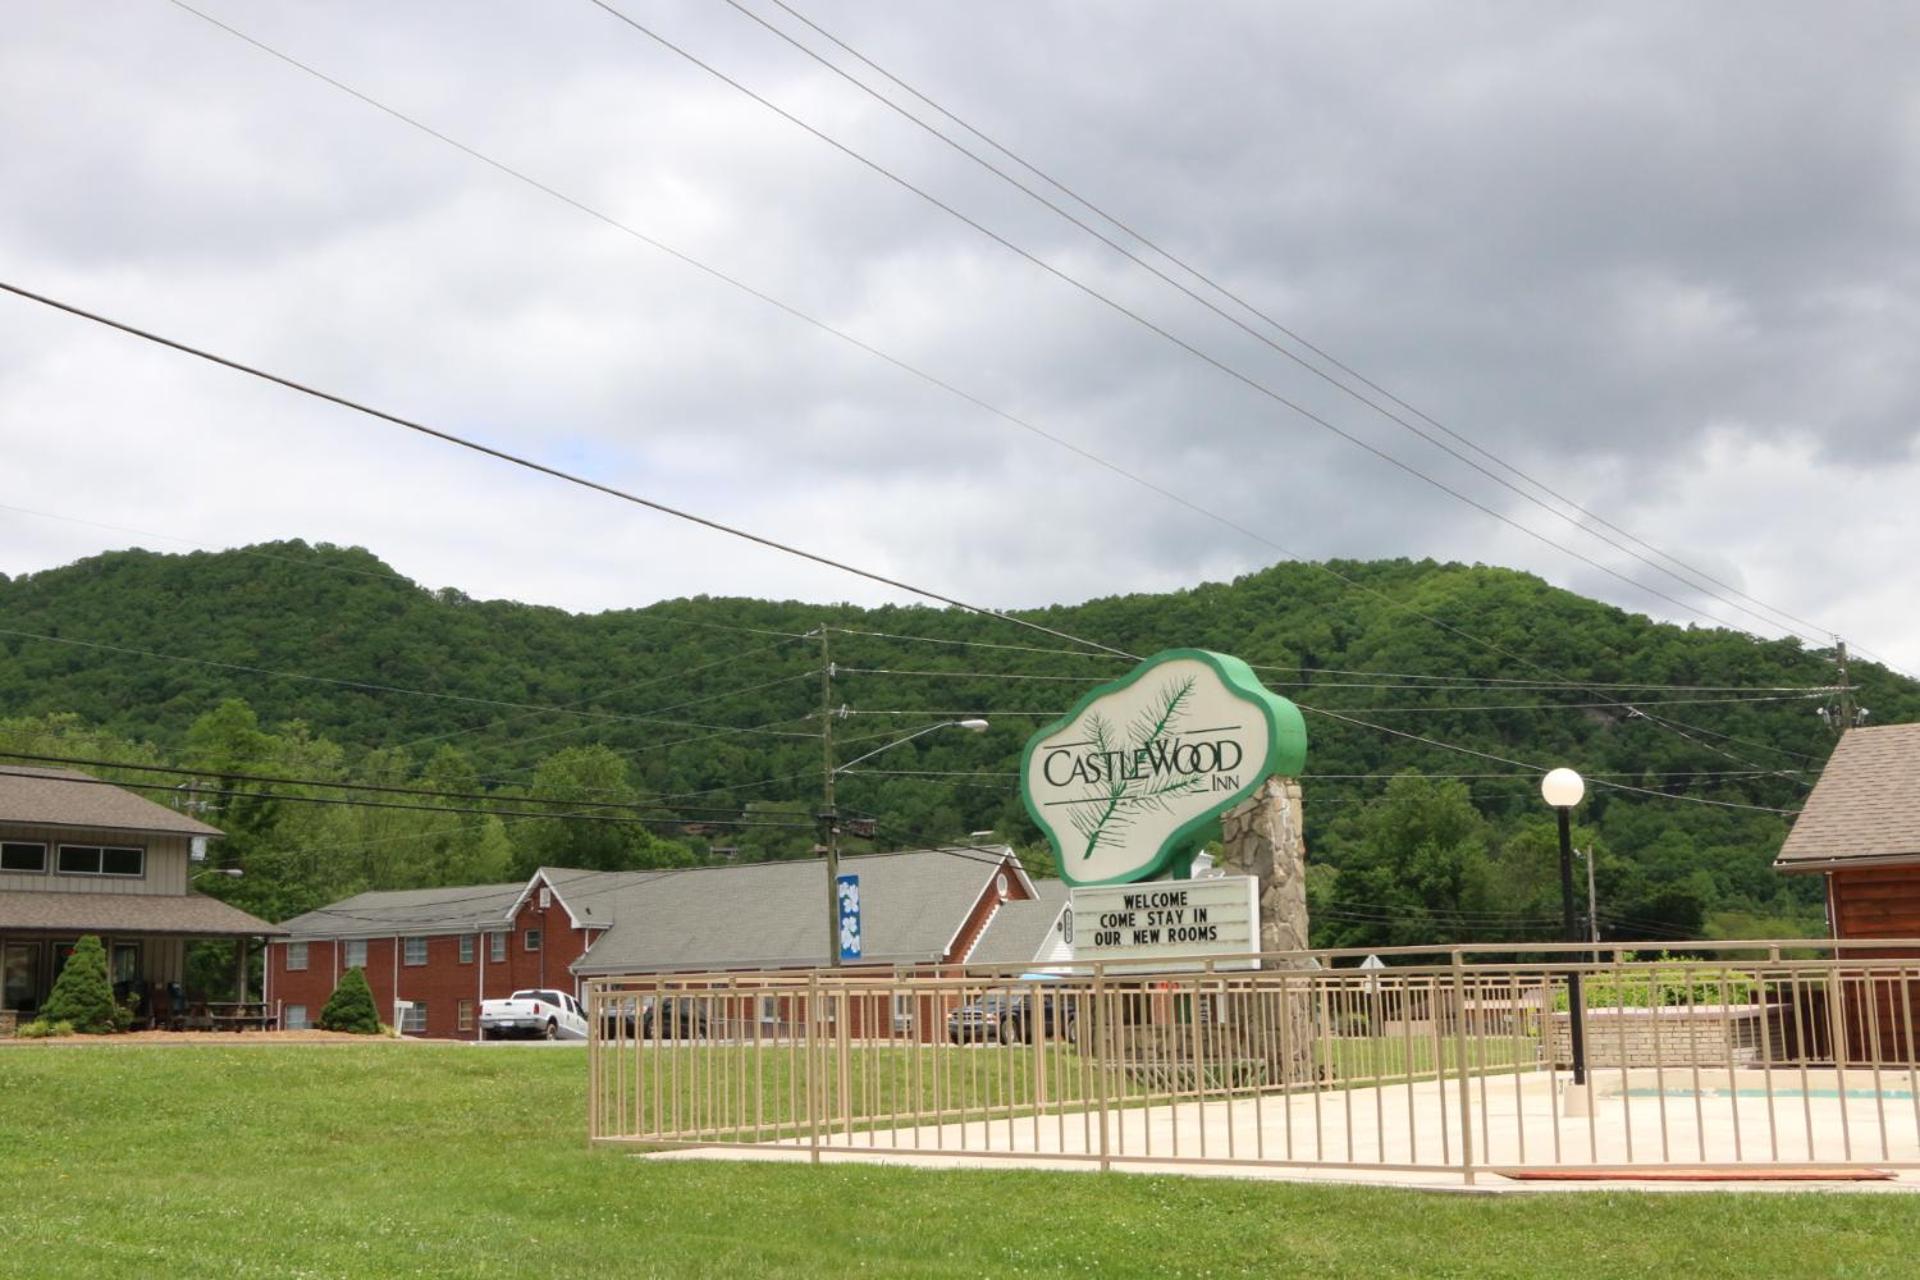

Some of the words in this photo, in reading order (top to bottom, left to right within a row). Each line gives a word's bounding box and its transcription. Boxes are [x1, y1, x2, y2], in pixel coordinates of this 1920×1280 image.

[1043, 737, 1243, 787] CASTLEWOOD
[1212, 774, 1240, 792] INN
[1124, 891, 1187, 909] WELCOME
[1100, 913, 1136, 928] COME
[1147, 909, 1184, 926] STAY
[1194, 908, 1207, 923] IN
[1095, 931, 1121, 946] OUR
[1133, 929, 1160, 944] NEW
[1168, 926, 1217, 942] ROOMS
